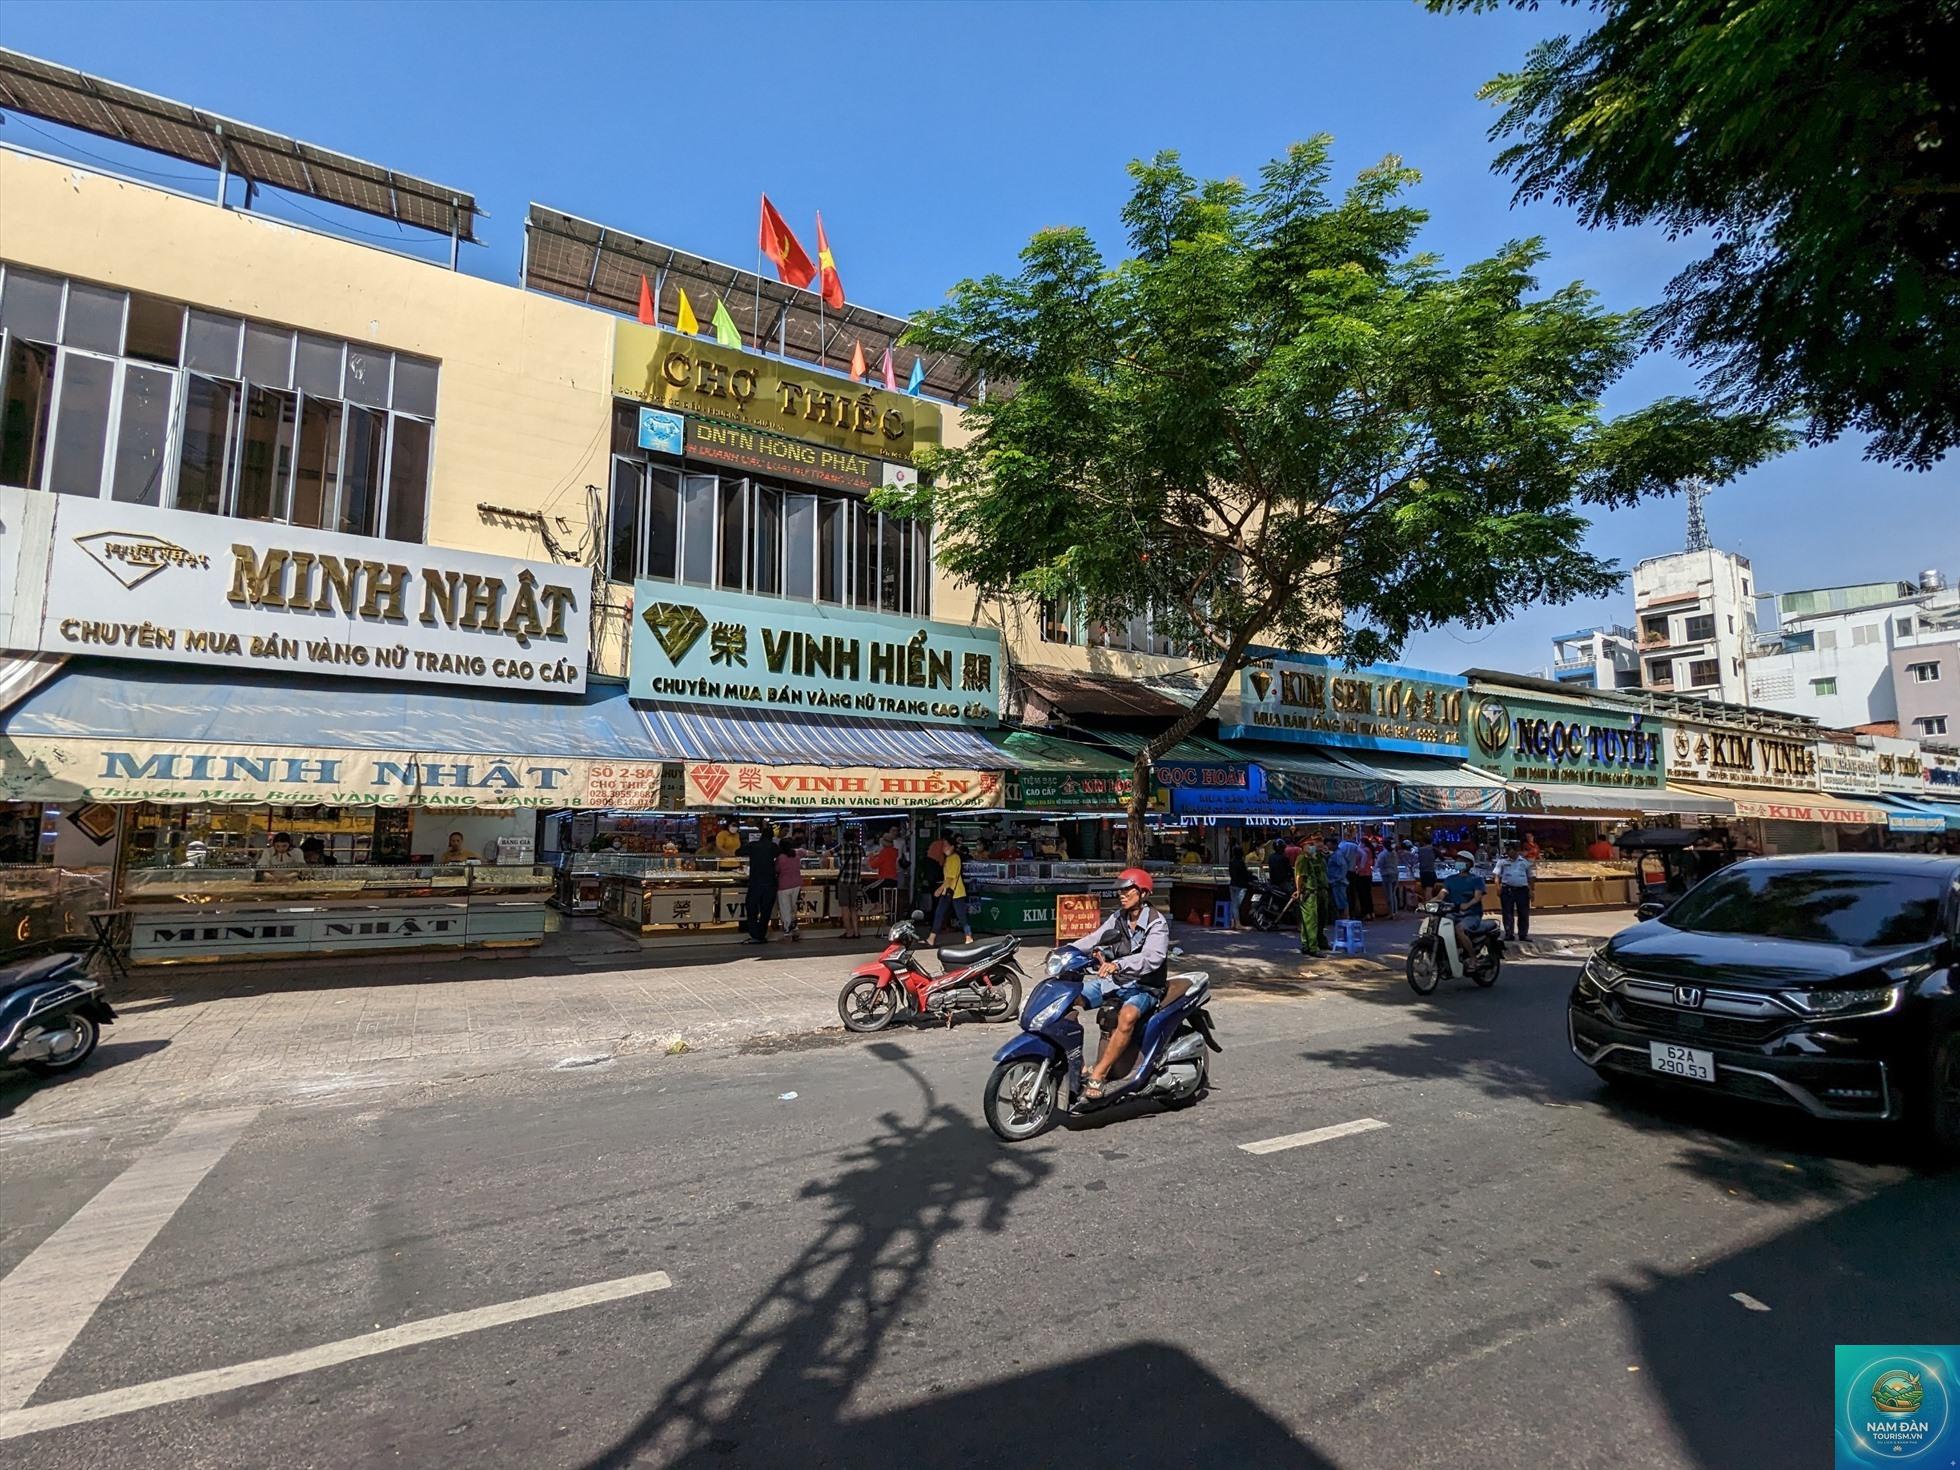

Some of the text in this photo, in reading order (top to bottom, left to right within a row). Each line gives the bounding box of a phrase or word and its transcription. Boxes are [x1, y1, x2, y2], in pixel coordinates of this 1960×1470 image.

[662, 351, 759, 412] CHỢ
[776, 380, 905, 440] THIẾC
[697, 425, 753, 450] DNTN
[226, 543, 578, 644] MINH NHẬT
[60, 618, 579, 684] CHUYÊN MUA BÁN VÀNG NỮ TRANG CAO CẤP
[709, 621, 748, 668] 榮
[761, 627, 952, 690] VINH HIỂN
[652, 677, 721, 699] CHUYÊN
[724, 683, 763, 701] MUA
[767, 685, 802, 705] BÁN
[807, 688, 852, 709] VÀNG
[855, 693, 875, 711] NỮ
[878, 699, 928, 716] TRANG
[931, 702, 960, 718] CAO
[1280, 670, 1326, 712] KIM
[1330, 677, 1372, 714] SEN
[1253, 711, 1281, 727] MUA
[1284, 712, 1307, 730] BÁN
[1513, 713, 1662, 765] NGỌC TUYẾT
[1710, 732, 1755, 770] KIM
[1757, 738, 1807, 775] VINH
[98, 752, 570, 795] MINH NHẬT
[591, 765, 655, 779] SỐ 2-8A
[738, 765, 762, 791] 榮
[766, 771, 970, 795] VINH HIỂN
[1155, 767, 1197, 789] GỌC
[83, 786, 187, 801] Chuyên
[199, 788, 256, 801] Mua
[331, 791, 399, 805] VÀNG
[562, 797, 582, 807] 18
[1026, 788, 1040, 796] CAO
[1082, 778, 1105, 793] KIM
[735, 794, 786, 805] CHUYÊN
[791, 795, 817, 806] MUA
[821, 796, 844, 806] BÁN
[849, 795, 880, 806] VÀNG
[903, 797, 938, 807] TRANG
[1768, 805, 1812, 820] KIM
[1818, 808, 1866, 822] VINH
[1024, 910, 1048, 922] KIM
[154, 918, 457, 943] MINH NHẬT
[1667, 1046, 1695, 1063] 62A
[1657, 1058, 1707, 1079] 290.53
